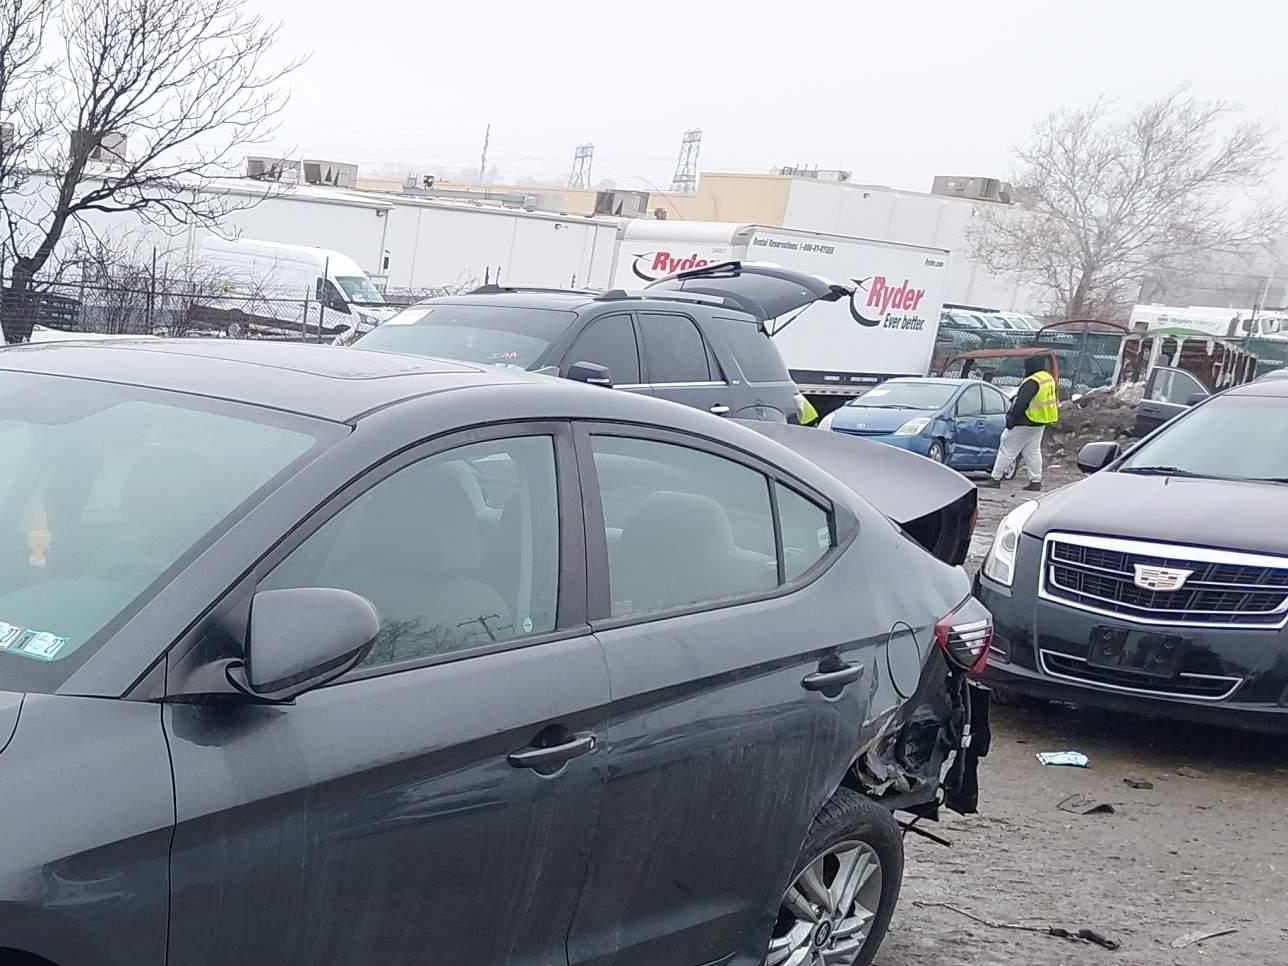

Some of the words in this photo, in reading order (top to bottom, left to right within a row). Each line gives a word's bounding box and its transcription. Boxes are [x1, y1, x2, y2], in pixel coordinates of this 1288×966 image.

[651, 251, 721, 274] Ryde
[866, 275, 925, 316] Ryder
[883, 313, 902, 329] Ever
[901, 314, 925, 331] better.
